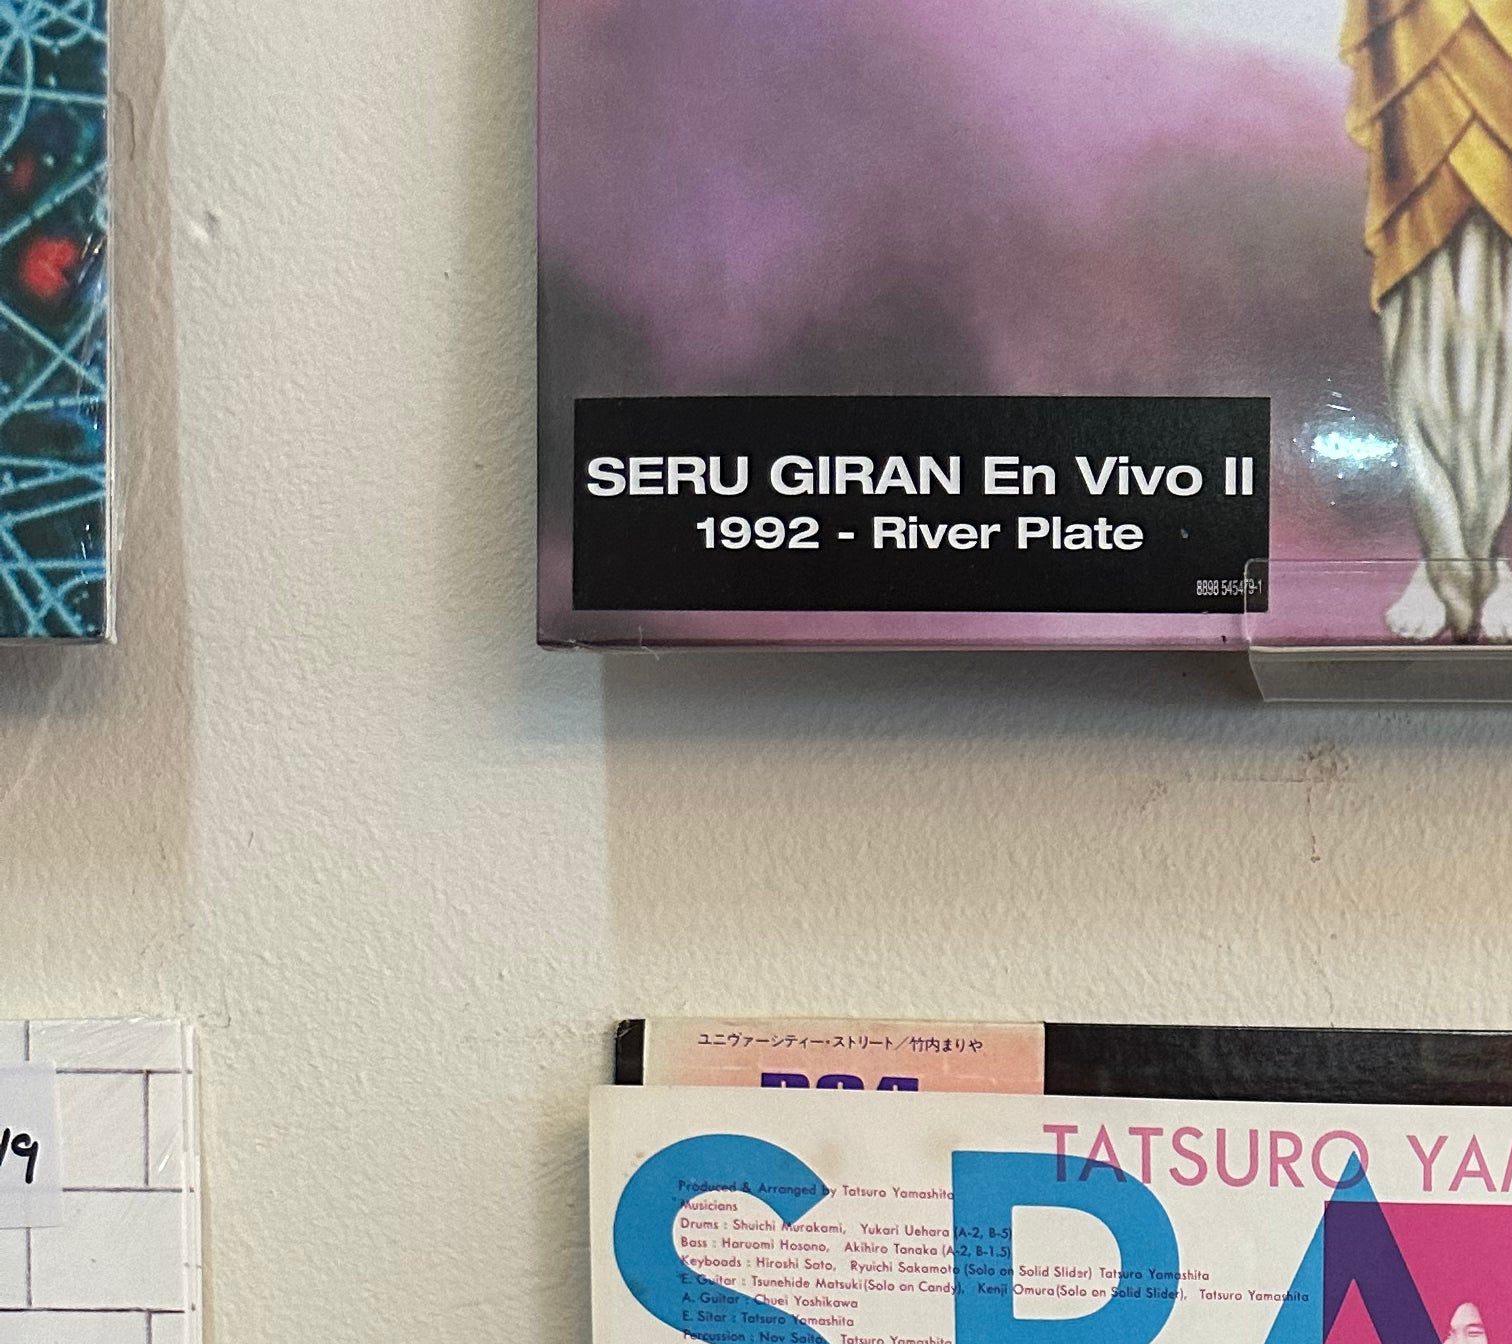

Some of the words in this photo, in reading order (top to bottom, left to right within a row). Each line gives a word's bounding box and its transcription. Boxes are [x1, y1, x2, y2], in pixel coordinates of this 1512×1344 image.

[586, 455, 749, 498] SERU
[770, 455, 961, 498] GIRAN
[985, 456, 1056, 496] En
[1074, 455, 1202, 498] Vivo
[1225, 456, 1254, 496] II
[696, 516, 820, 550] 1992
[872, 516, 1000, 551] River
[1016, 516, 1144, 551] Plate
[1042, 1124, 1369, 1191] TATSURO
[681, 1218, 719, 1230] Drums
[733, 1220, 776, 1231] Shuichi
[860, 1224, 899, 1235] Yukari
[905, 1225, 949, 1237] Uehara
[681, 1237, 707, 1248] Bass
[722, 1238, 774, 1249] Haruomi
[845, 1243, 887, 1254] Akihiro
[894, 1244, 937, 1256] Tanaka
